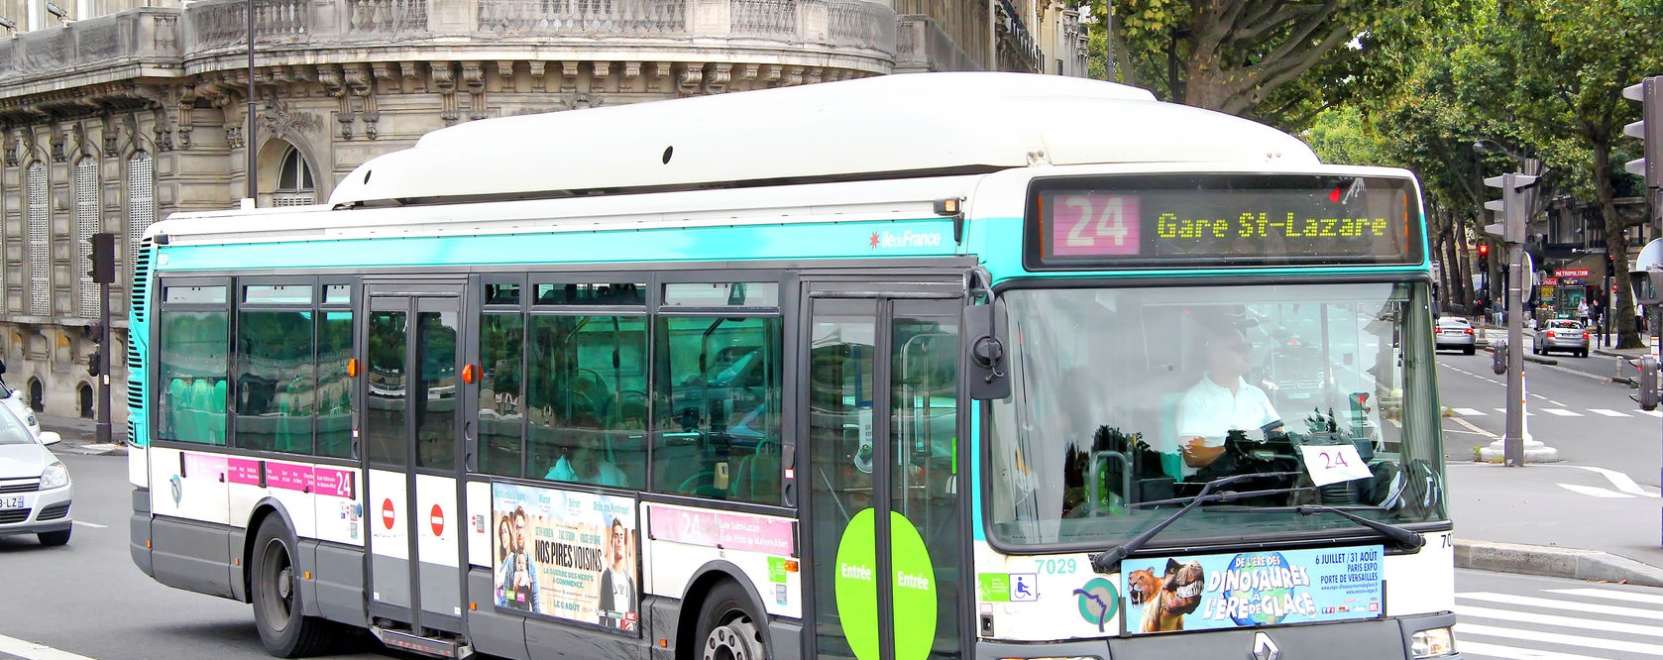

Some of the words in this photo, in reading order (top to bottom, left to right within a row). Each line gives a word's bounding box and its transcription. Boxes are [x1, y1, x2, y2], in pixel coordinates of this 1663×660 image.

[1066, 196, 1127, 247] 24
[1157, 212, 1229, 238] Gare
[1239, 211, 1388, 238] St-Lazare
[1319, 449, 1348, 470] 24
[336, 471, 351, 497] 24
[535, 539, 550, 564] NOS
[551, 541, 573, 569] PIRES
[573, 545, 603, 573] VOISINS
[1035, 559, 1077, 574] 7029
[1235, 557, 1245, 568] DE
[1266, 555, 1280, 567] DES
[1315, 554, 1320, 565] 6
[1321, 553, 1345, 564] JUILLET
[1350, 552, 1358, 562] 31
[841, 562, 872, 581] Entrée
[1320, 574, 1338, 584] PORTE
[1339, 574, 1347, 583] DE
[1348, 572, 1378, 582] VERSAILLES
[1347, 563, 1362, 573] PARIS
[1364, 562, 1378, 572] EXPO
[897, 570, 929, 591] Entrée
[1207, 565, 1311, 592] DINOSAURES
[1261, 592, 1317, 617] GLACE
